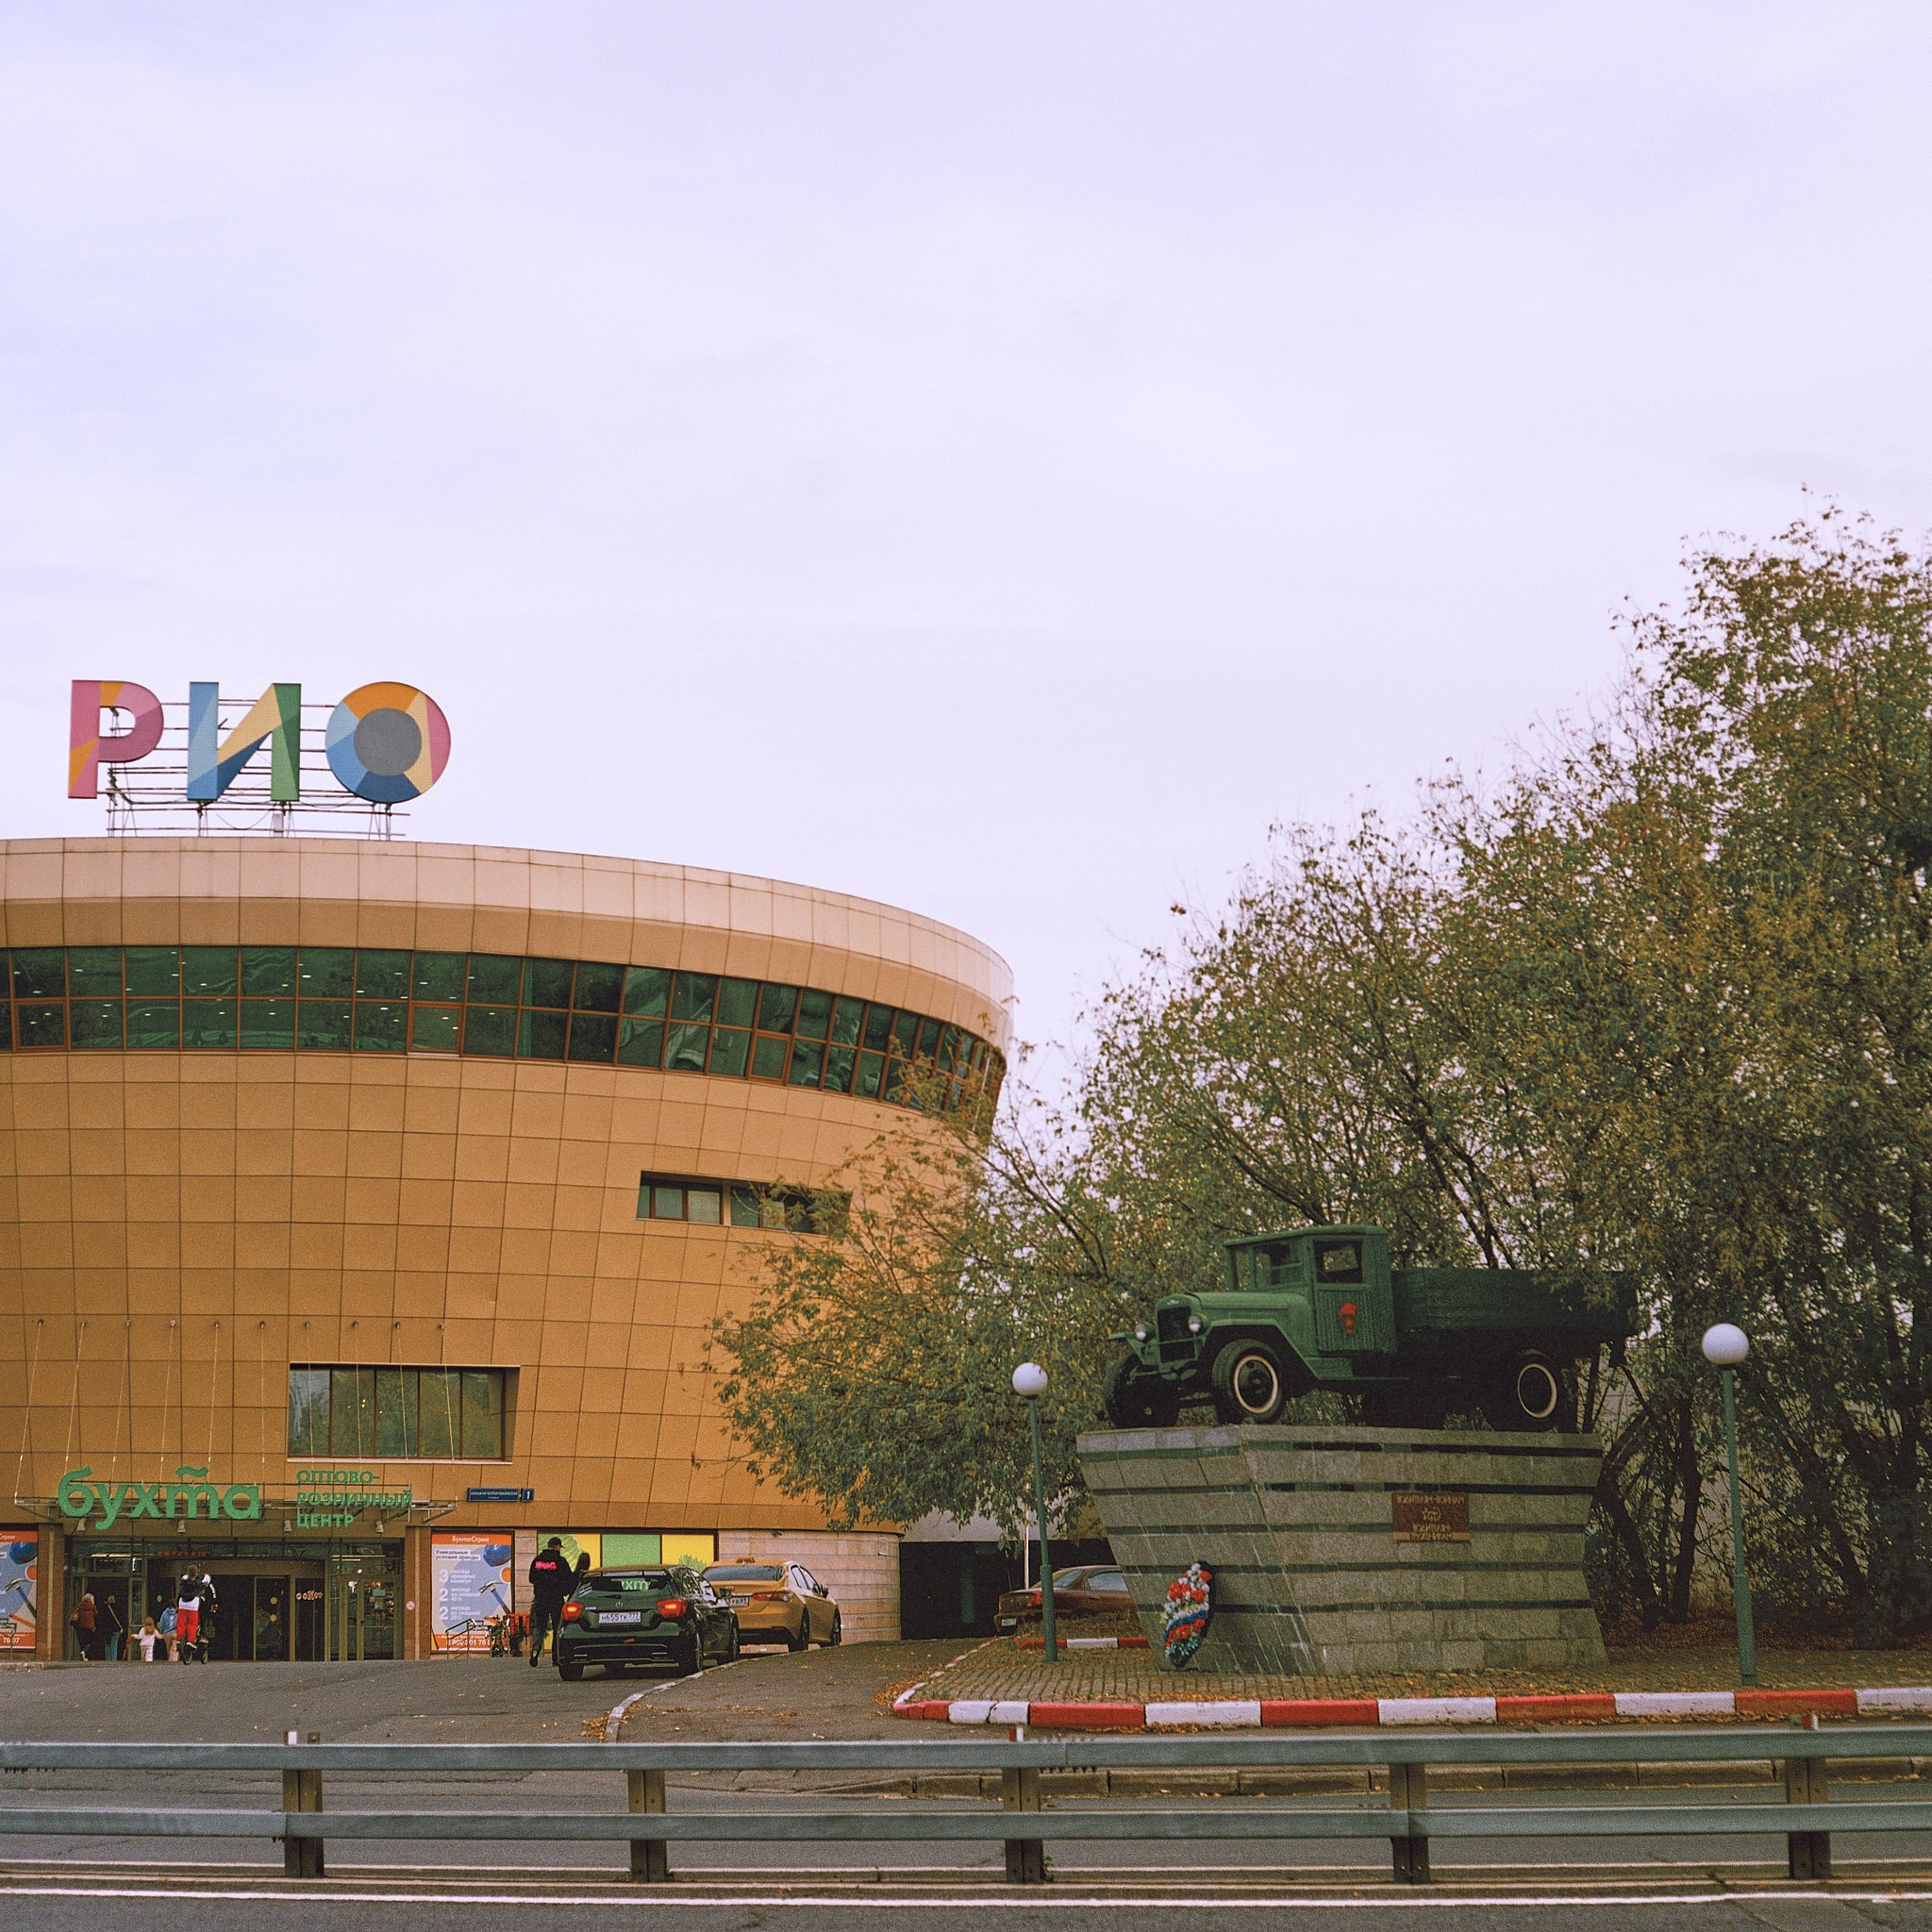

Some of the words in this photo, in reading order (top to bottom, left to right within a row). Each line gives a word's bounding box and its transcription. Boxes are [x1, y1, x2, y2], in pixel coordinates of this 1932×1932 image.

[68, 679, 452, 804] РИО
[296, 1469, 380, 1484] ОПТОВО-
[58, 1465, 259, 1530] бухта
[296, 1490, 412, 1507] РОЗНИЧНЫЙ
[526, 1491, 530, 1500] 1
[296, 1513, 355, 1529] ЦЕНТР
[439, 1569, 449, 1583] 3
[439, 1588, 449, 1601] 2
[439, 1607, 449, 1620] 2
